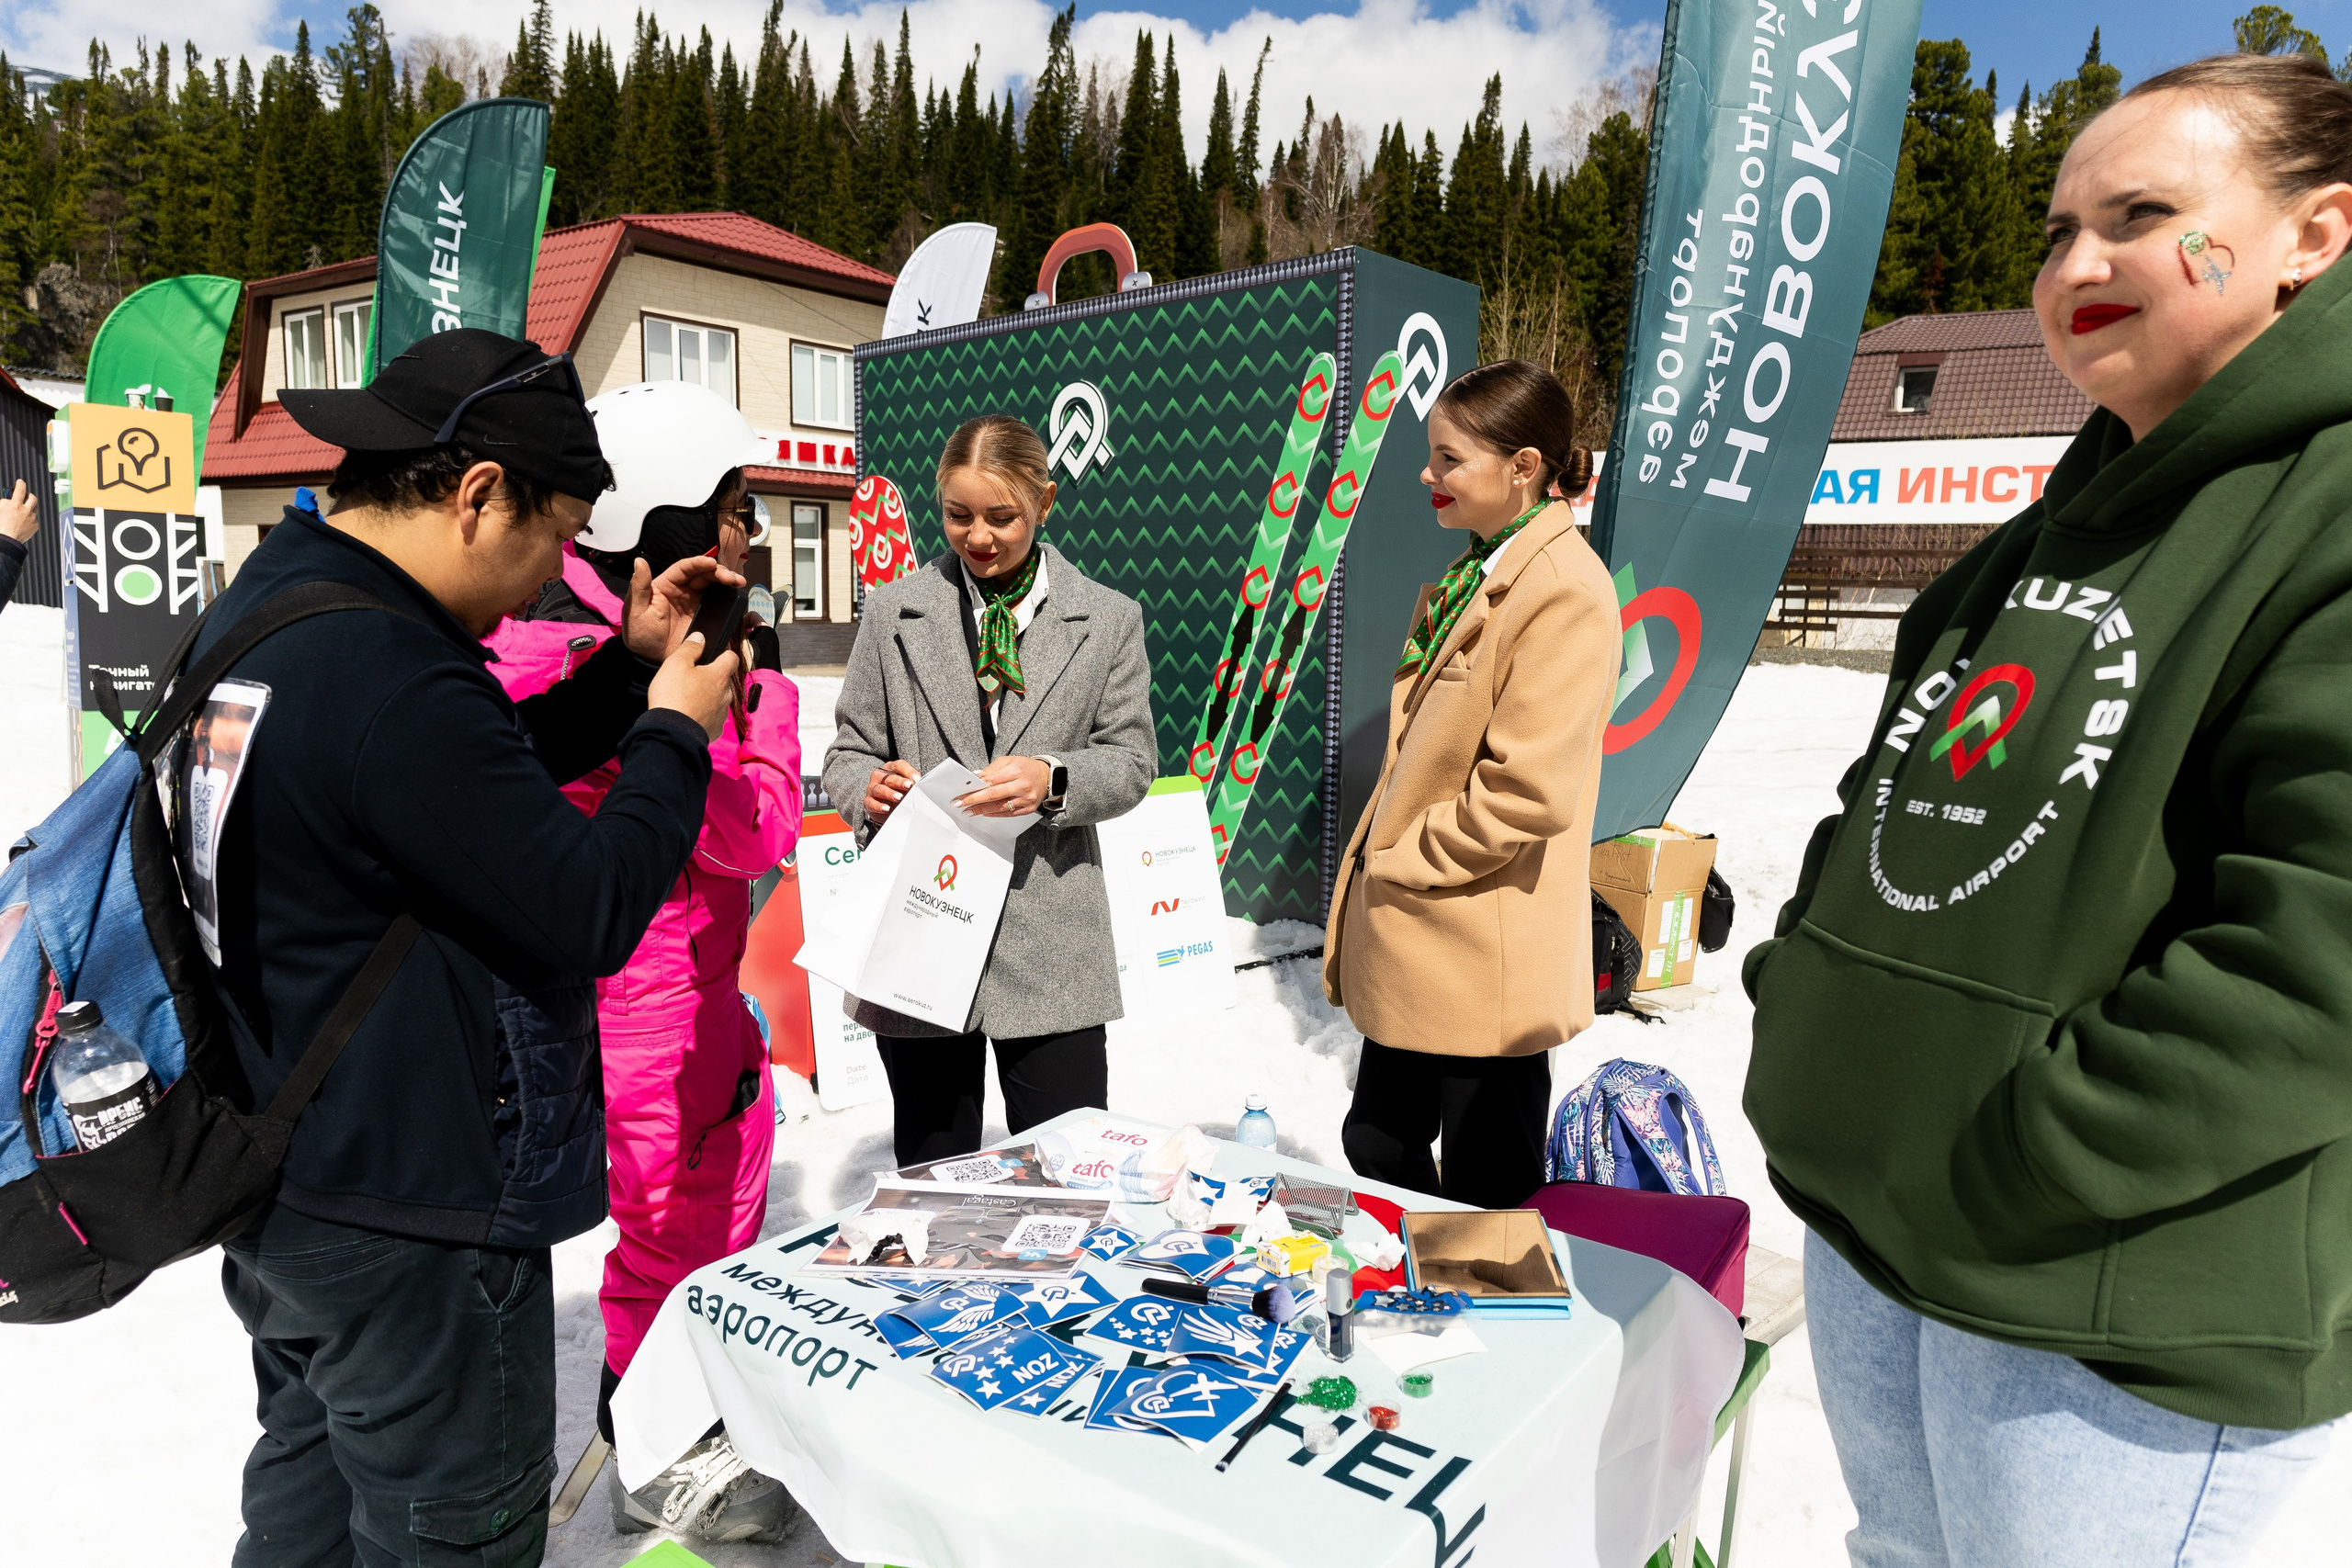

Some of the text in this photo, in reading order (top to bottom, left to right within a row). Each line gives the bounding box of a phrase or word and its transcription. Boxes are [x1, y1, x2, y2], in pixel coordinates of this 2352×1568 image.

[428, 180, 468, 334] ЗНЕЦК
[776, 439, 855, 467] ЯШКА
[1810, 466, 2058, 504] АЯ ИНСТ
[88, 664, 150, 678] чный
[89, 681, 155, 691] вигат
[1905, 799, 1988, 826] EST. 1952
[1869, 778, 2059, 912] INTERNATIONAL AIRPORT
[909, 885, 975, 924] НОВОКУЗНЕЦК
[1187, 940, 1214, 957] PEGAS
[893, 992, 933, 1011] www.aerokuz.ru
[843, 1022, 864, 1032] пер
[844, 1030, 876, 1043] на дво
[846, 1064, 867, 1075] Date
[1101, 1128, 1148, 1146] tafo
[963, 1194, 1017, 1208] Castagal
[686, 1282, 879, 1391] аэропорт
[1012, 1352, 1059, 1384] NOZ
